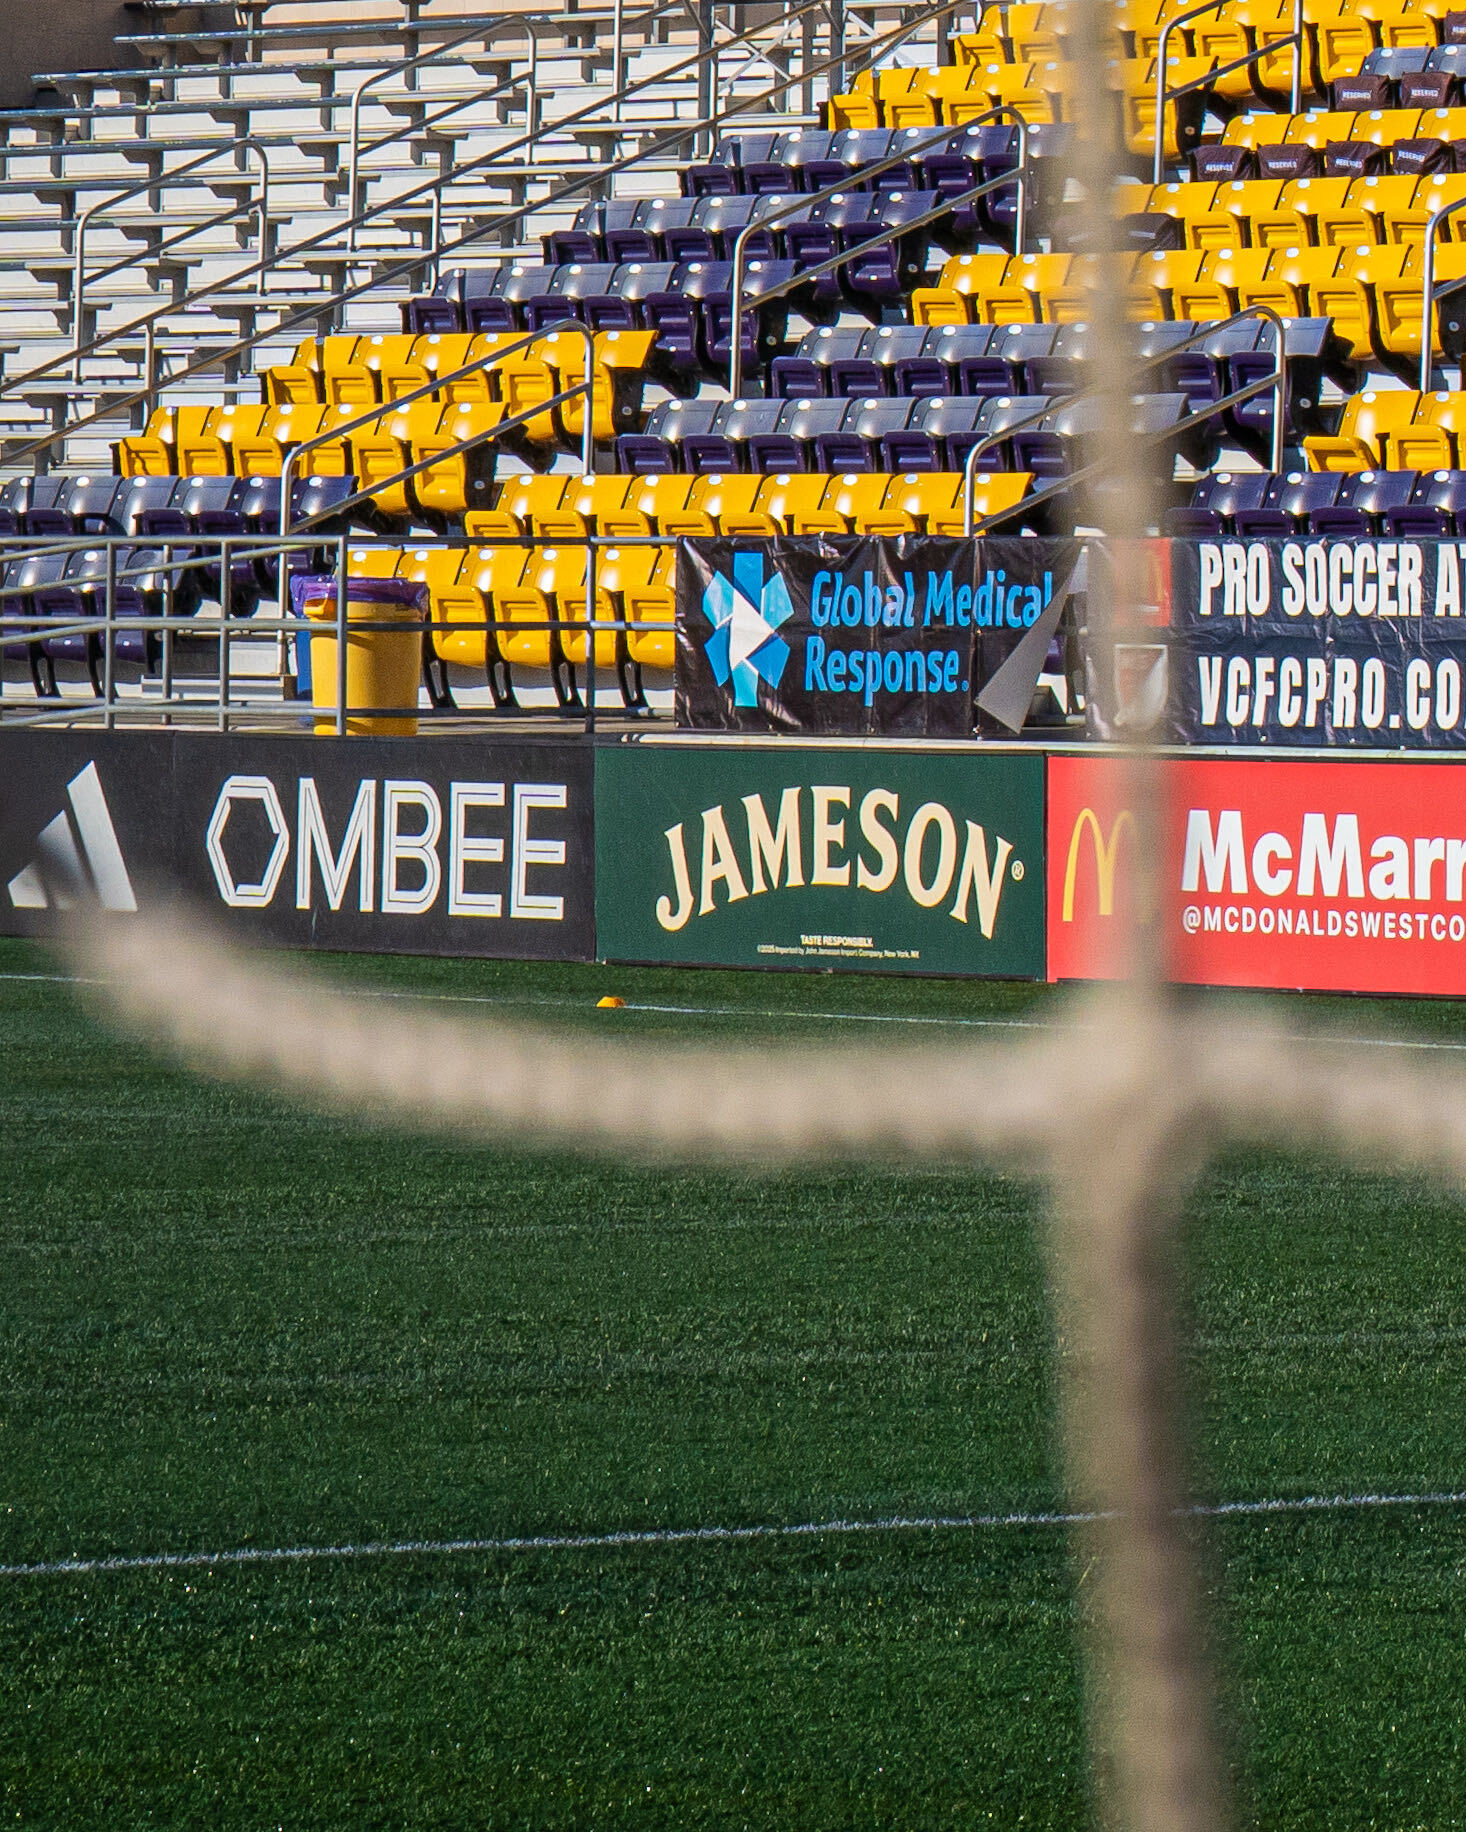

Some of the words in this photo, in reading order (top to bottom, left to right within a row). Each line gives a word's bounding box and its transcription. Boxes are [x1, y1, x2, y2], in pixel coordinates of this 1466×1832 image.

[1268, 159, 1298, 169] RESERVED
[811, 570, 915, 628] Global
[923, 570, 1053, 628] Medical
[1199, 542, 1271, 616] PRO
[1281, 543, 1423, 617] SOCCER
[206, 774, 567, 921] OMBEE
[800, 934, 823, 946] TASTE
